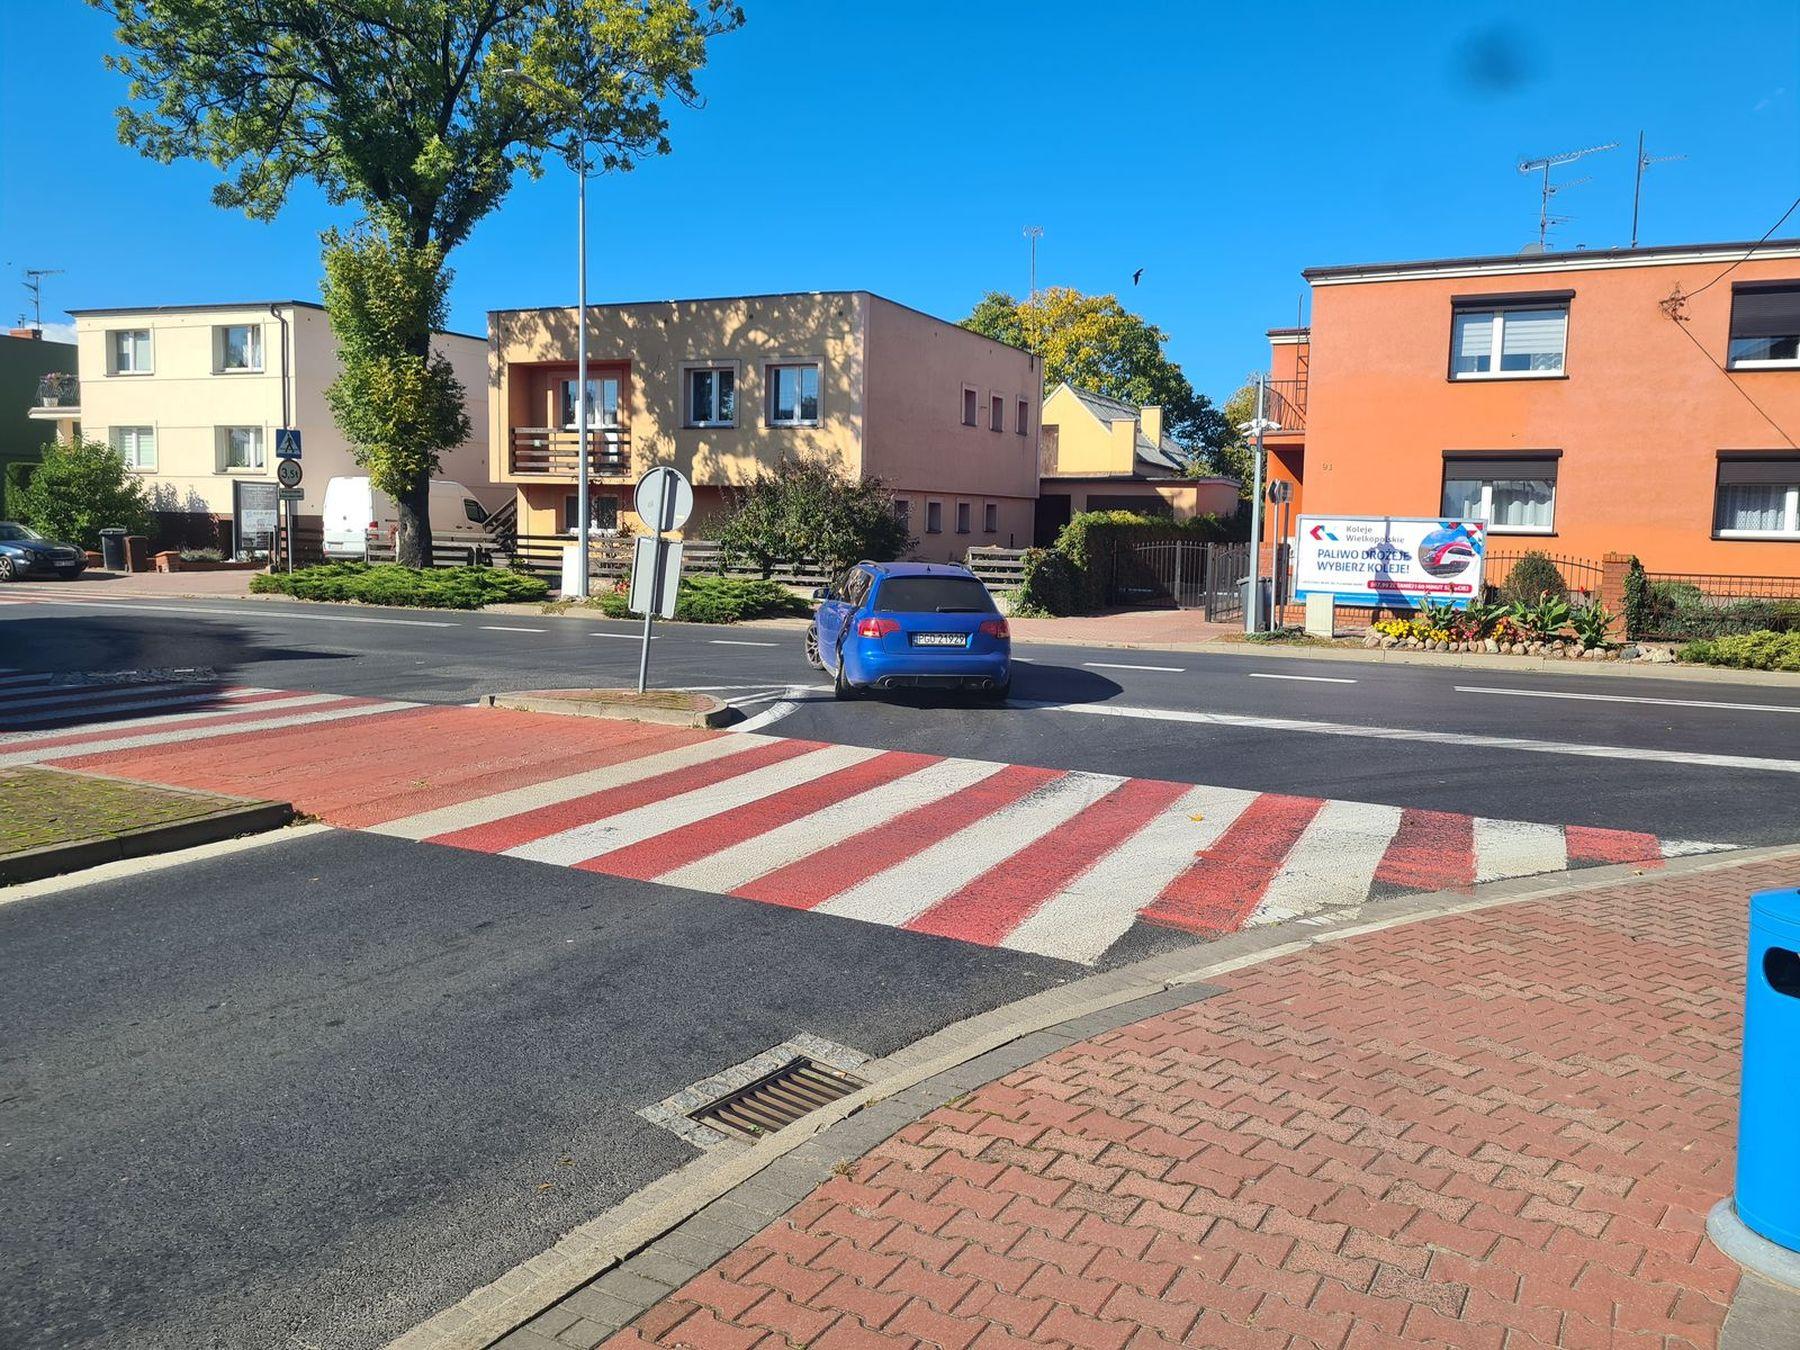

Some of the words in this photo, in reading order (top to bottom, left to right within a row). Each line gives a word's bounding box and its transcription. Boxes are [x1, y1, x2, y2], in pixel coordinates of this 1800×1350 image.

[1322, 463, 1333, 471] 91
[1346, 526, 1373, 534] Koleje
[1346, 535, 1405, 543] Wielkopolskie
[1318, 549, 1359, 559] PALIWO
[1362, 549, 1410, 561] DROŻEJE
[1367, 562, 1410, 574] KOLEJE!
